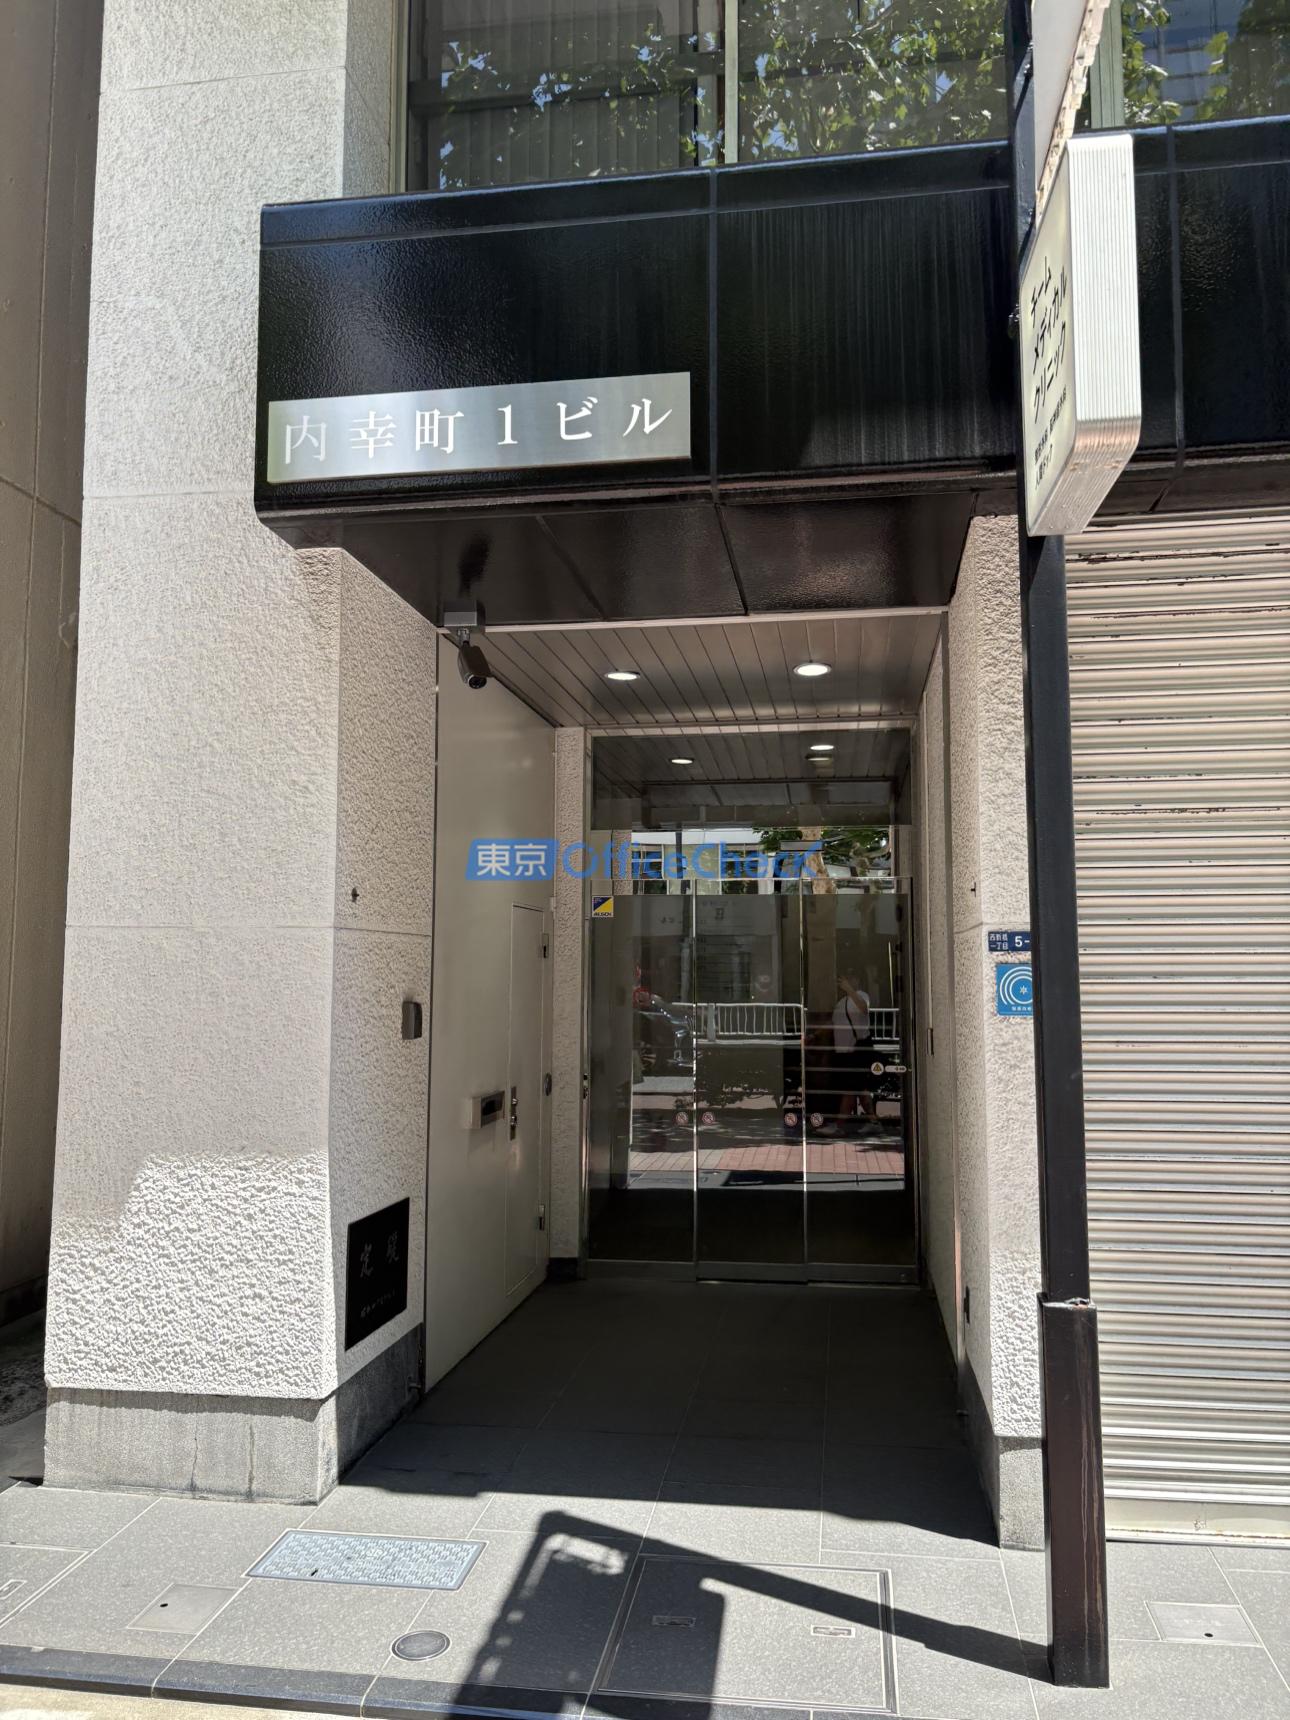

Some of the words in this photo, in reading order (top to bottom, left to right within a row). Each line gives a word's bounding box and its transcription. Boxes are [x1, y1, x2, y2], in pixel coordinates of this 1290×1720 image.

[1033, 265, 1067, 375] メディカル
[1034, 321, 1066, 424] クリニック
